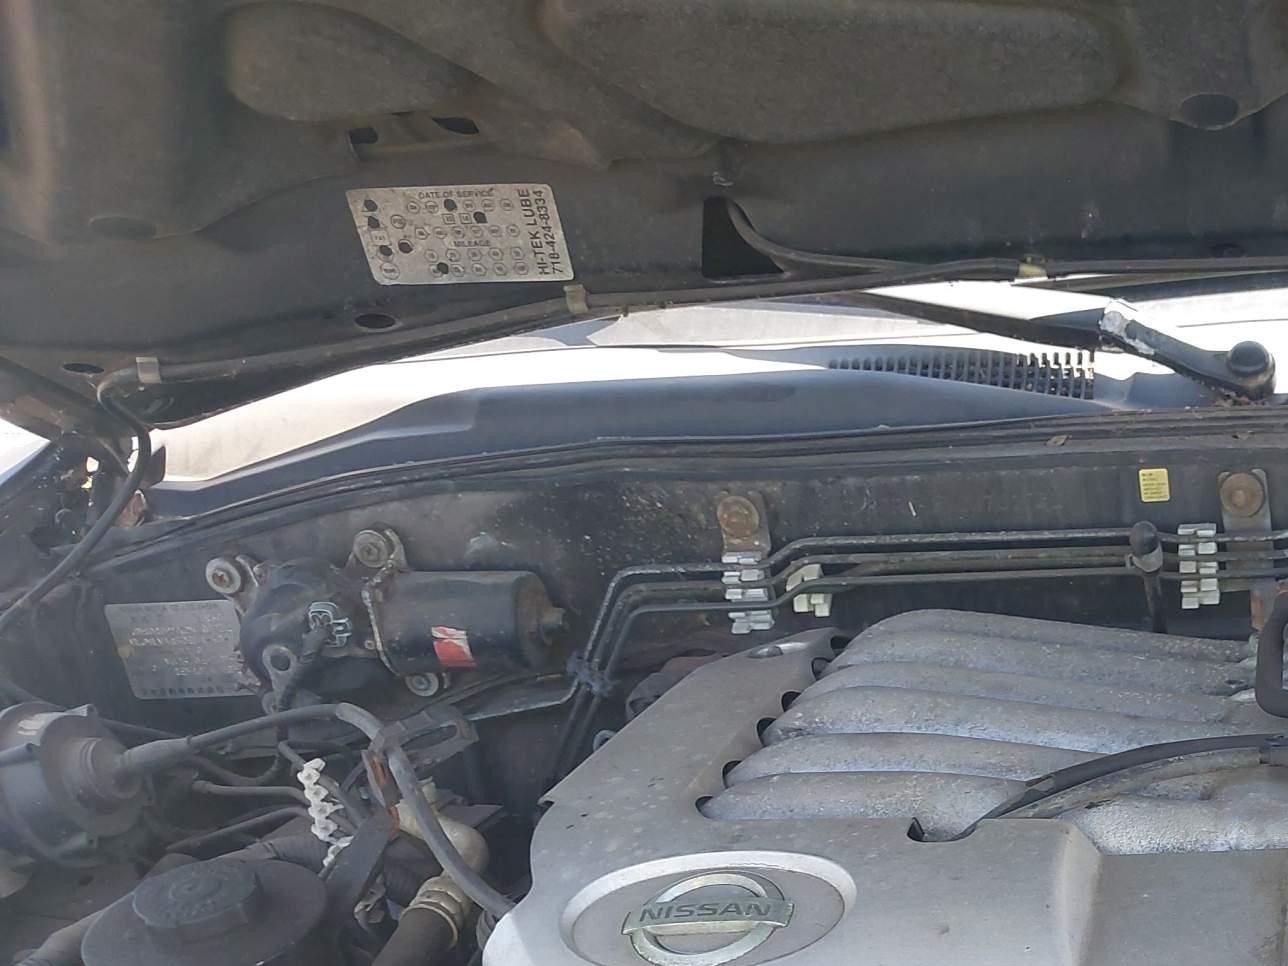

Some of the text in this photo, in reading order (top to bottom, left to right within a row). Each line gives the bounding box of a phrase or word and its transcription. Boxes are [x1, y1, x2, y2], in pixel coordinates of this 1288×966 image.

[418, 188, 494, 199] DATE OF SERVICE
[517, 187, 549, 276] HI-TEK LUBE
[532, 189, 563, 275] 718-424-8334
[453, 239, 491, 247] MILEAGE
[639, 902, 772, 923] NISSAN
